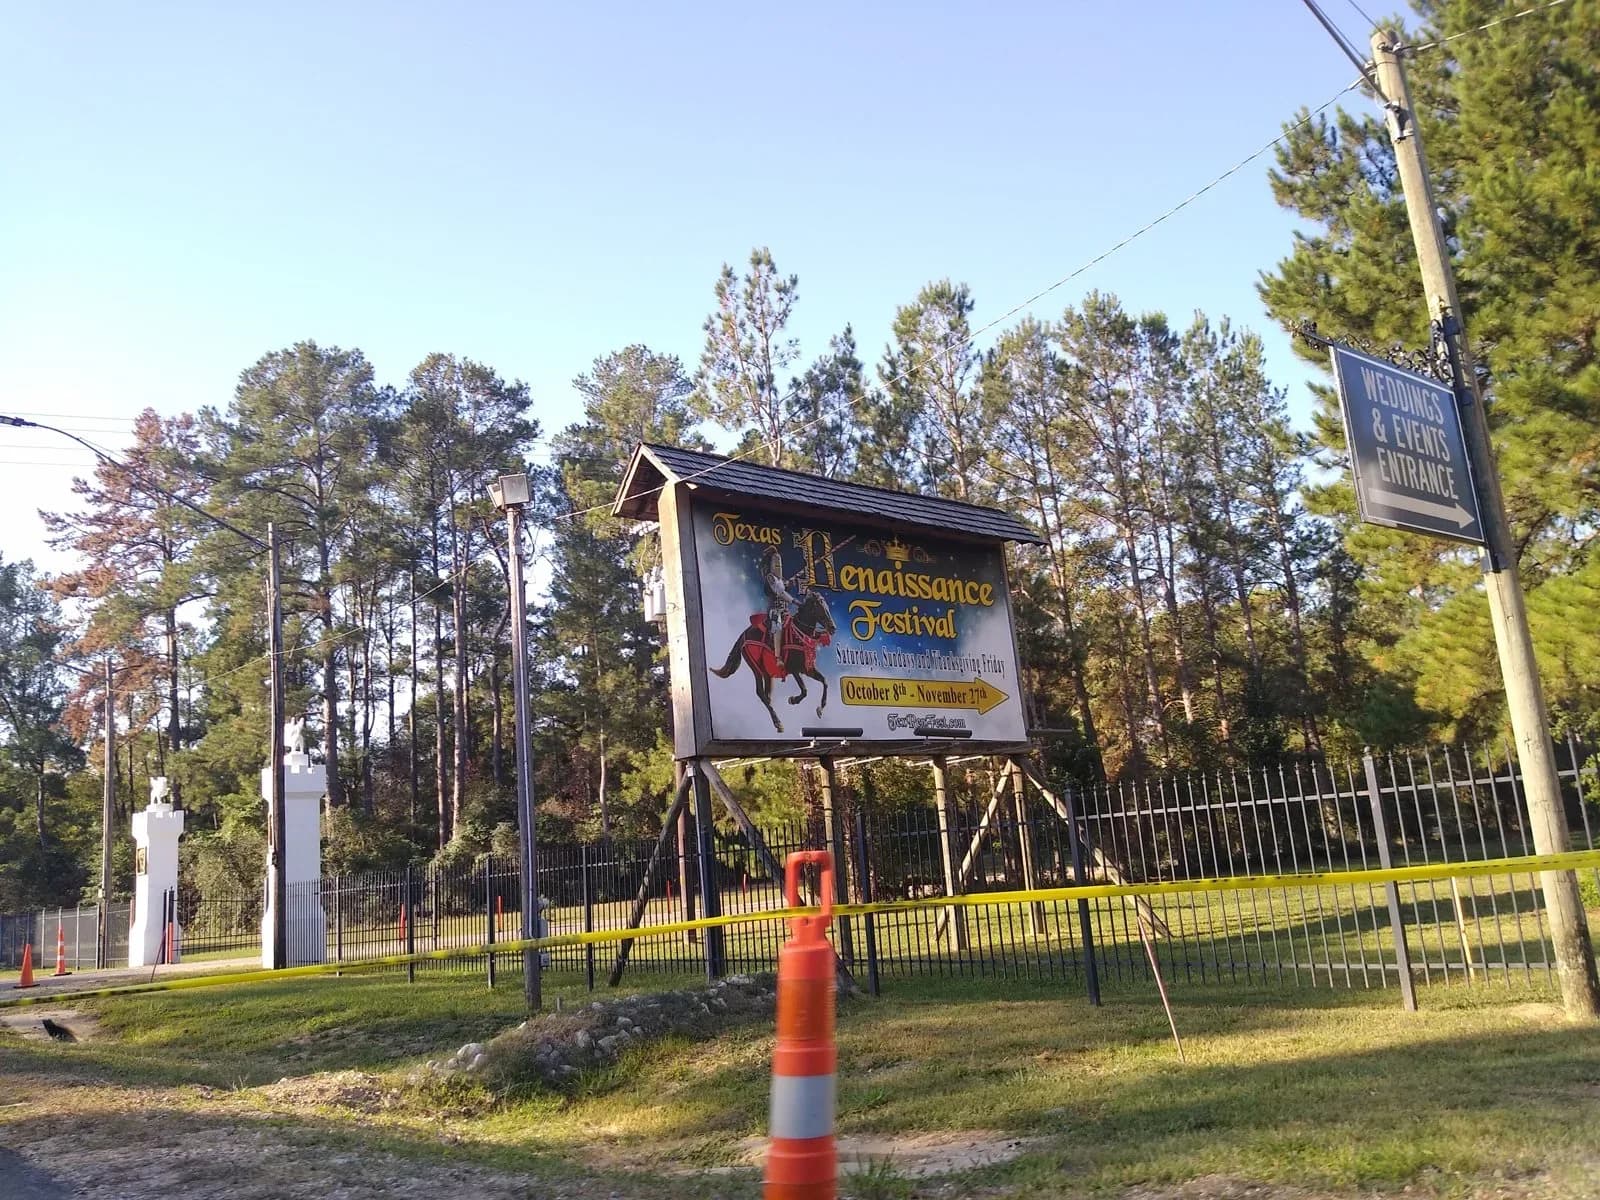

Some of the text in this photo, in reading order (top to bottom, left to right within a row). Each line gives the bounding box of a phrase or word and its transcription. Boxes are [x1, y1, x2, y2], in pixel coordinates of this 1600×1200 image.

[1361, 367, 1444, 425] WEDDINGS
[1372, 407, 1450, 462] & EVENTS
[1376, 447, 1459, 500] ENTRANCE
[712, 512, 782, 546] Texas
[792, 528, 994, 607] Renaissance
[849, 599, 958, 641] Festival
[882, 645, 915, 673] Sundays
[982, 653, 1005, 678] Friday
[846, 680, 890, 701] October
[893, 682, 907, 701] 8th
[916, 684, 967, 704] November
